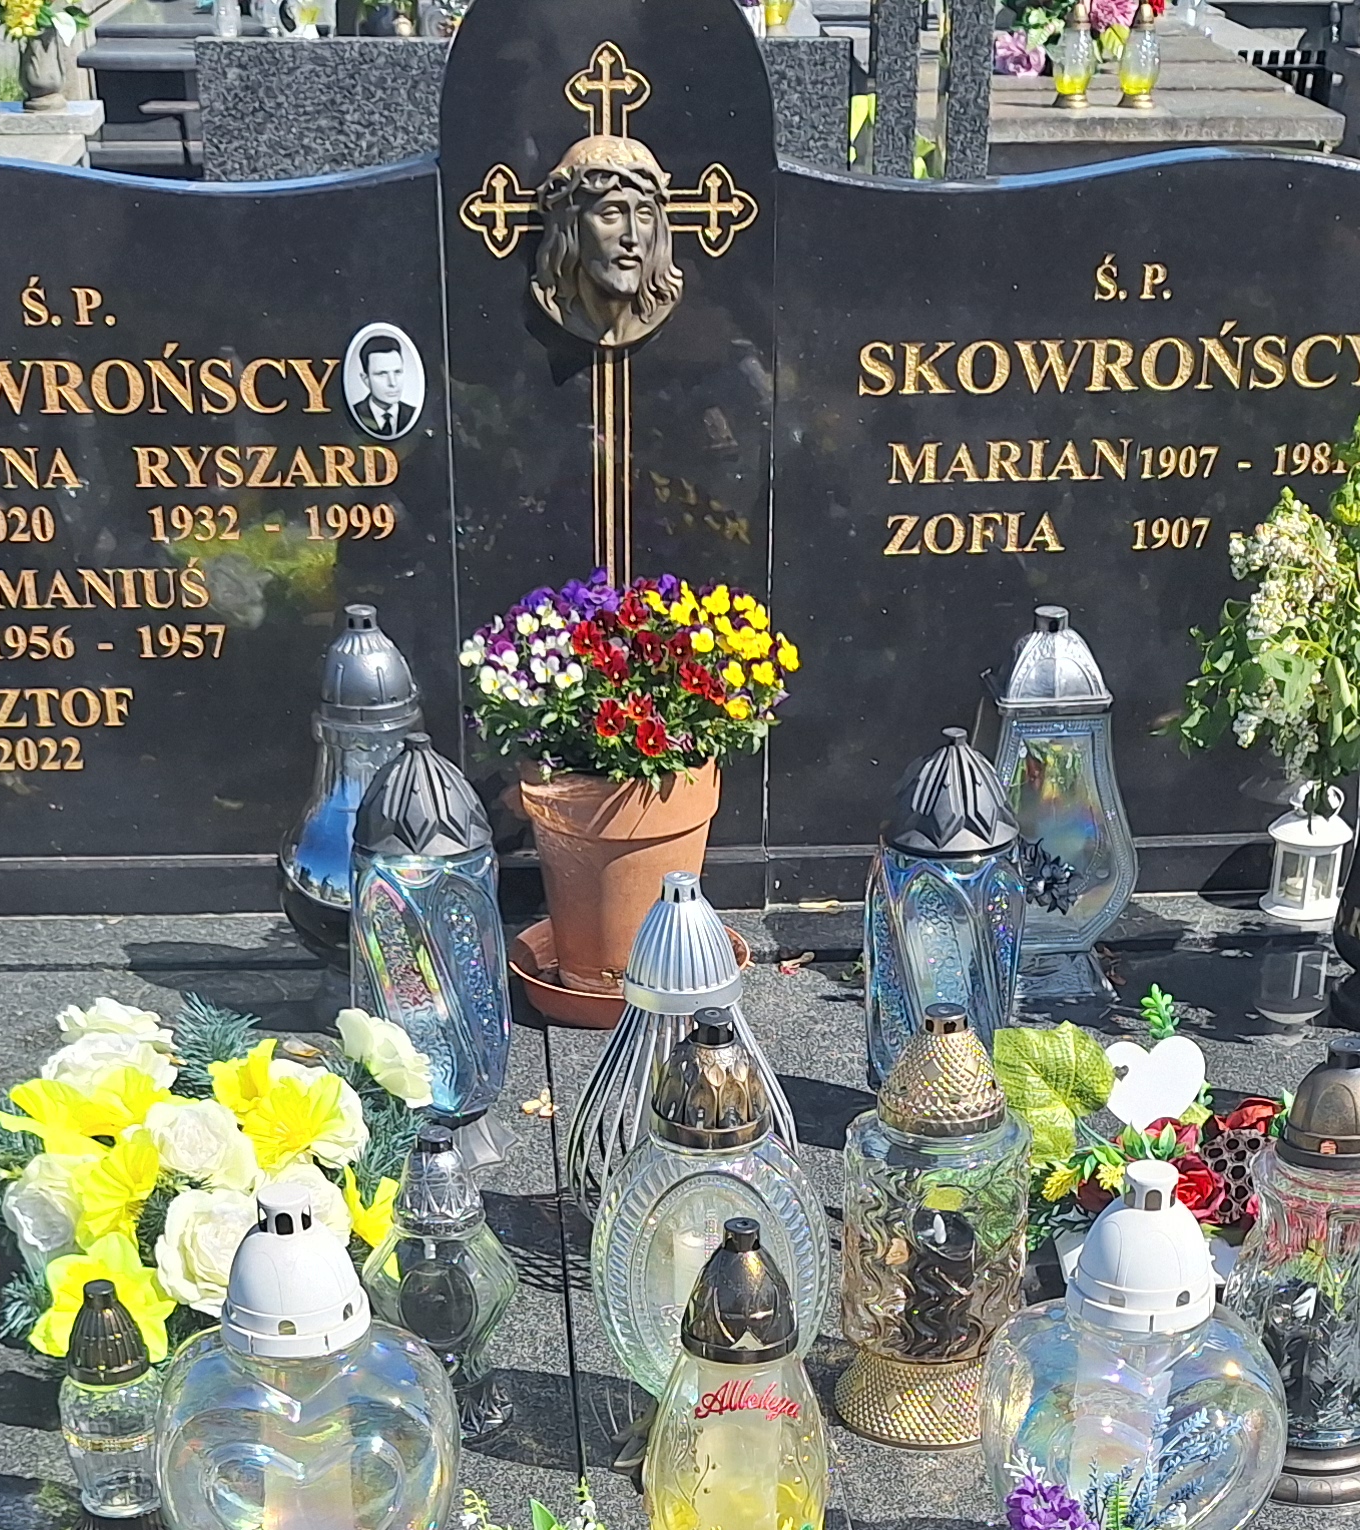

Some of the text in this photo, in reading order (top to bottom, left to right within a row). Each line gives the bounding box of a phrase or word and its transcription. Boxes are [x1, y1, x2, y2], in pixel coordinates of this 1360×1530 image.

[1095, 253, 1173, 301] Ś. P.
[21, 276, 118, 328] Ś. P.
[132, 445, 400, 489] RYSZARD
[888, 438, 1133, 485] MARIAN
[1140, 445, 1220, 480] 1907
[148, 504, 242, 543] 1932
[305, 503, 398, 542] 1999
[883, 512, 1065, 557] ZOFIA
[1130, 518, 1212, 551] 1907
[137, 623, 228, 660] 1957
